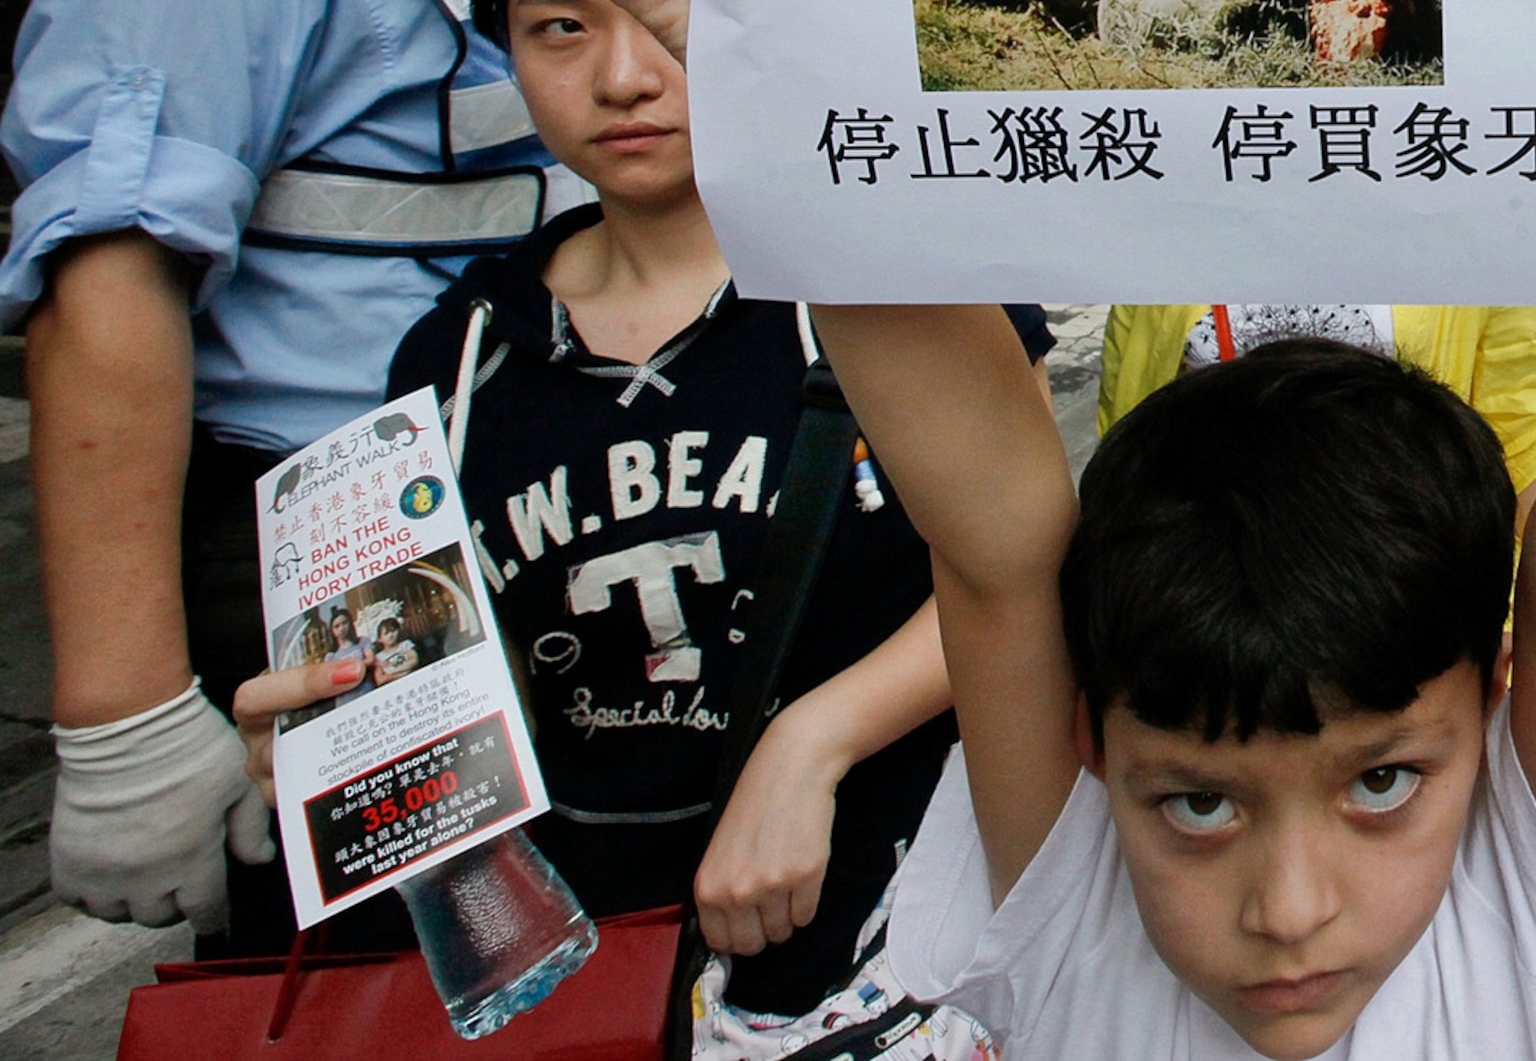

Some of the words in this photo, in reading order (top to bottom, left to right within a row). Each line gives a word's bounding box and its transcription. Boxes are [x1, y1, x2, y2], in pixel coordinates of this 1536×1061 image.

[816, 106, 1165, 184] 停止獵殺
[287, 460, 353, 507] ELEPHANT
[356, 436, 399, 472] WALK
[298, 552, 349, 592] HONG
[355, 525, 411, 563] KONG
[311, 533, 348, 565] BAN
[352, 514, 390, 543] THE
[298, 571, 352, 611] IVORY
[357, 540, 423, 581] TRADE
[318, 739, 383, 777] Government
[385, 733, 396, 745] to
[398, 714, 439, 738] destroy
[442, 706, 455, 718] its
[457, 691, 489, 711] entire
[327, 756, 374, 786] stockpile
[376, 749, 387, 761] of
[389, 720, 452, 755] confiscated
[454, 704, 485, 727] ivory!
[330, 742, 348, 758] We
[351, 732, 369, 748] call
[372, 726, 385, 738] on
[388, 717, 402, 730] the
[408, 701, 438, 720] Hong
[440, 687, 470, 706] Kong
[563, 687, 680, 740] Special
[343, 779, 366, 799] Did
[368, 768, 393, 789] you
[394, 751, 430, 774] know
[431, 736, 459, 758] that
[361, 769, 459, 833] 35,000
[343, 853, 374, 876] were
[375, 833, 413, 860] killed
[414, 822, 435, 841] for
[436, 811, 458, 830] the
[459, 793, 497, 819] tusks
[371, 854, 396, 875] last
[398, 841, 428, 864] year
[429, 816, 475, 847] alone?
